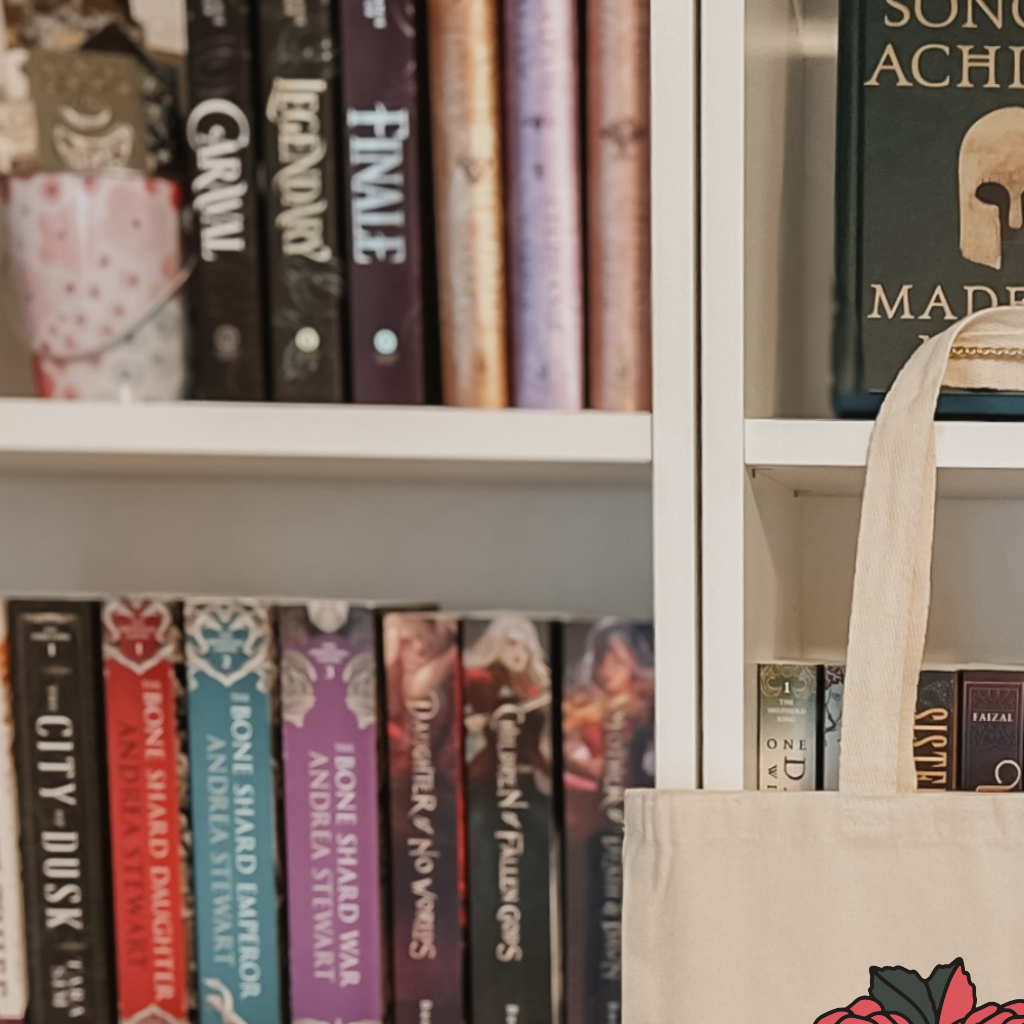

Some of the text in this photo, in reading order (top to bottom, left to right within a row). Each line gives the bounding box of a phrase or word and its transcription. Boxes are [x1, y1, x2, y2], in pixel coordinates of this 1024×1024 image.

[346, 101, 410, 265] FINALE
[141, 691, 166, 759] BONE
[229, 705, 254, 776] BONE
[766, 738, 808, 751] ONE
[972, 712, 1014, 723] FAIZAL
[35, 715, 84, 930] CITY DUSK
[146, 768, 170, 859] SHARD
[232, 782, 258, 875] SHARD
[333, 755, 358, 826] BONE
[308, 750, 337, 983] ANDREA STEWART
[335, 832, 361, 925] SHARD
[235, 882, 262, 1000] EMPEROR
[338, 929, 362, 989] WAR
